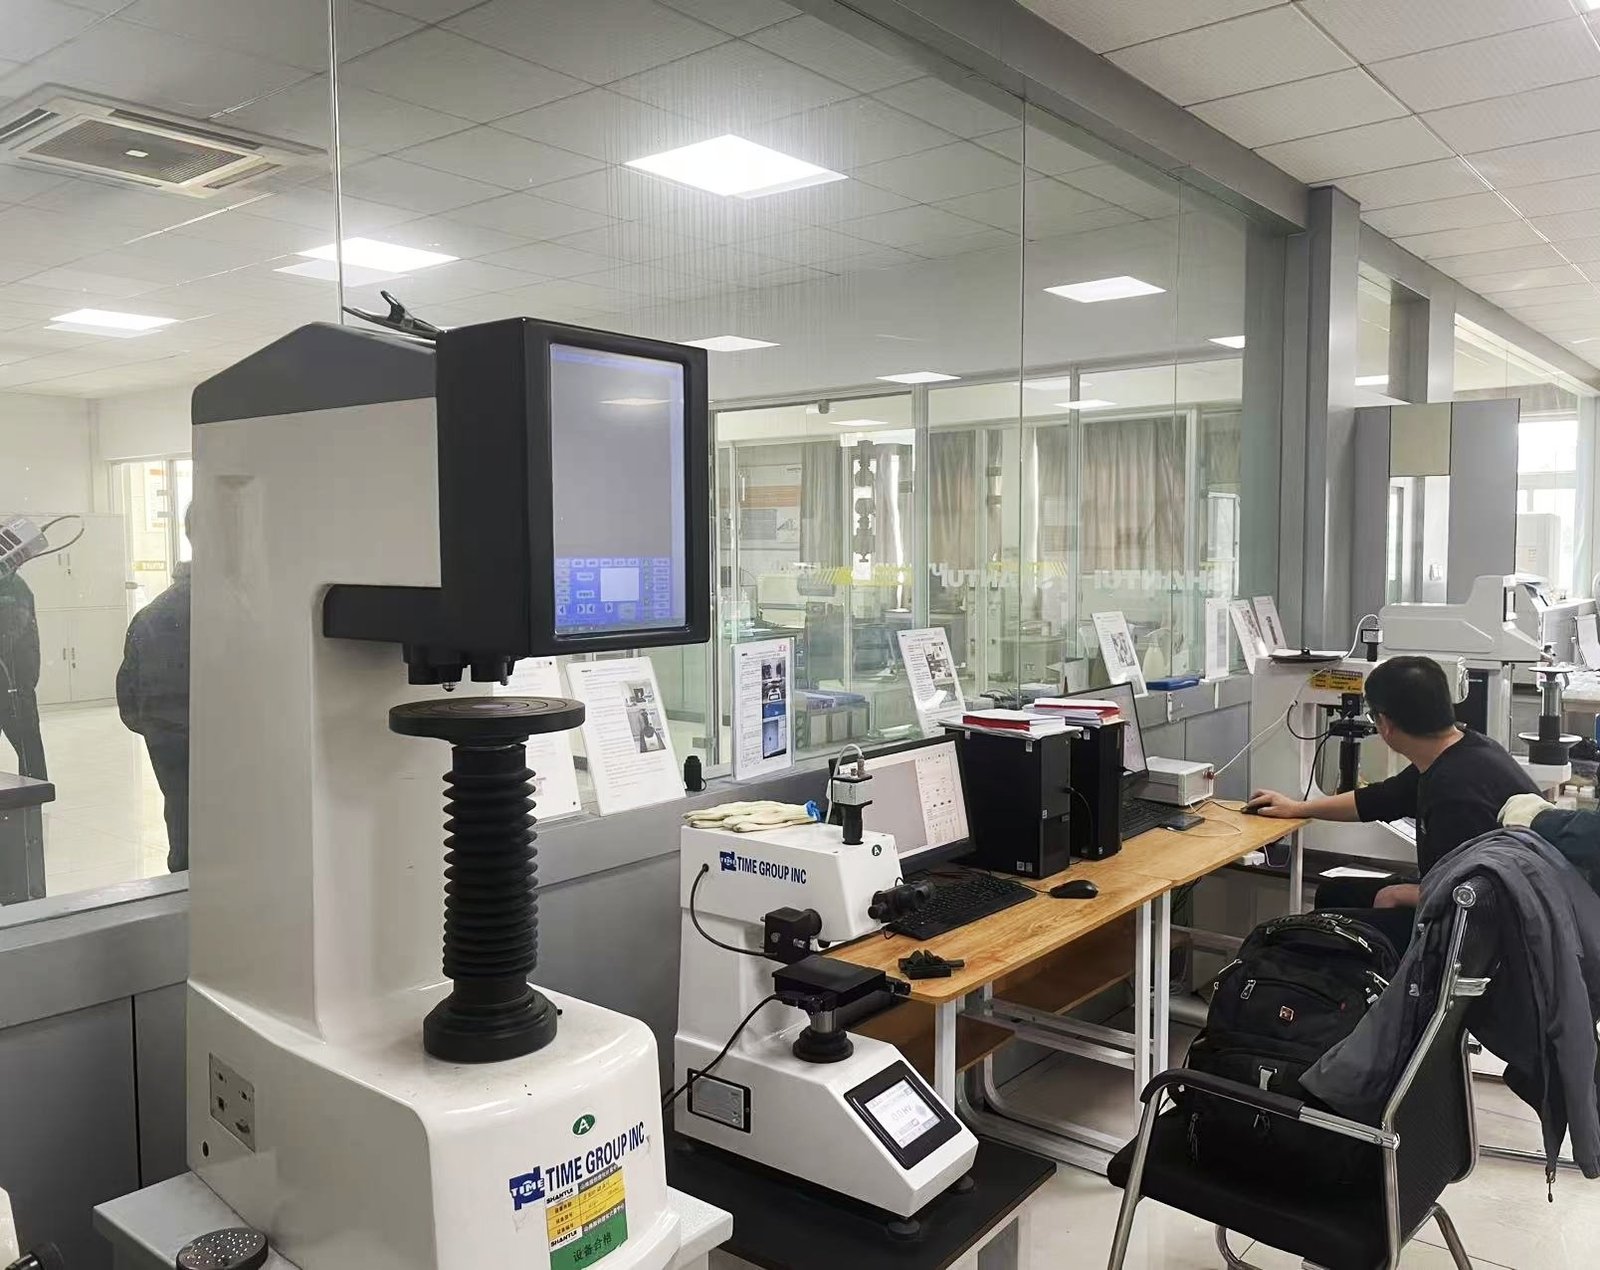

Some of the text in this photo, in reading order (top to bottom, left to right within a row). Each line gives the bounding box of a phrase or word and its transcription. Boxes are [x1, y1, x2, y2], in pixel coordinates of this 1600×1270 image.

[737, 856, 806, 884] TIME GROUP INC
[577, 1118, 590, 1134] A
[545, 1156, 582, 1192] TIME
[585, 1133, 627, 1174] GROUP
[628, 1121, 645, 1151] INC
[510, 1177, 545, 1197] TIME
[546, 1187, 573, 1204] SHANTUI
[550, 1230, 577, 1247] SHANTUI
